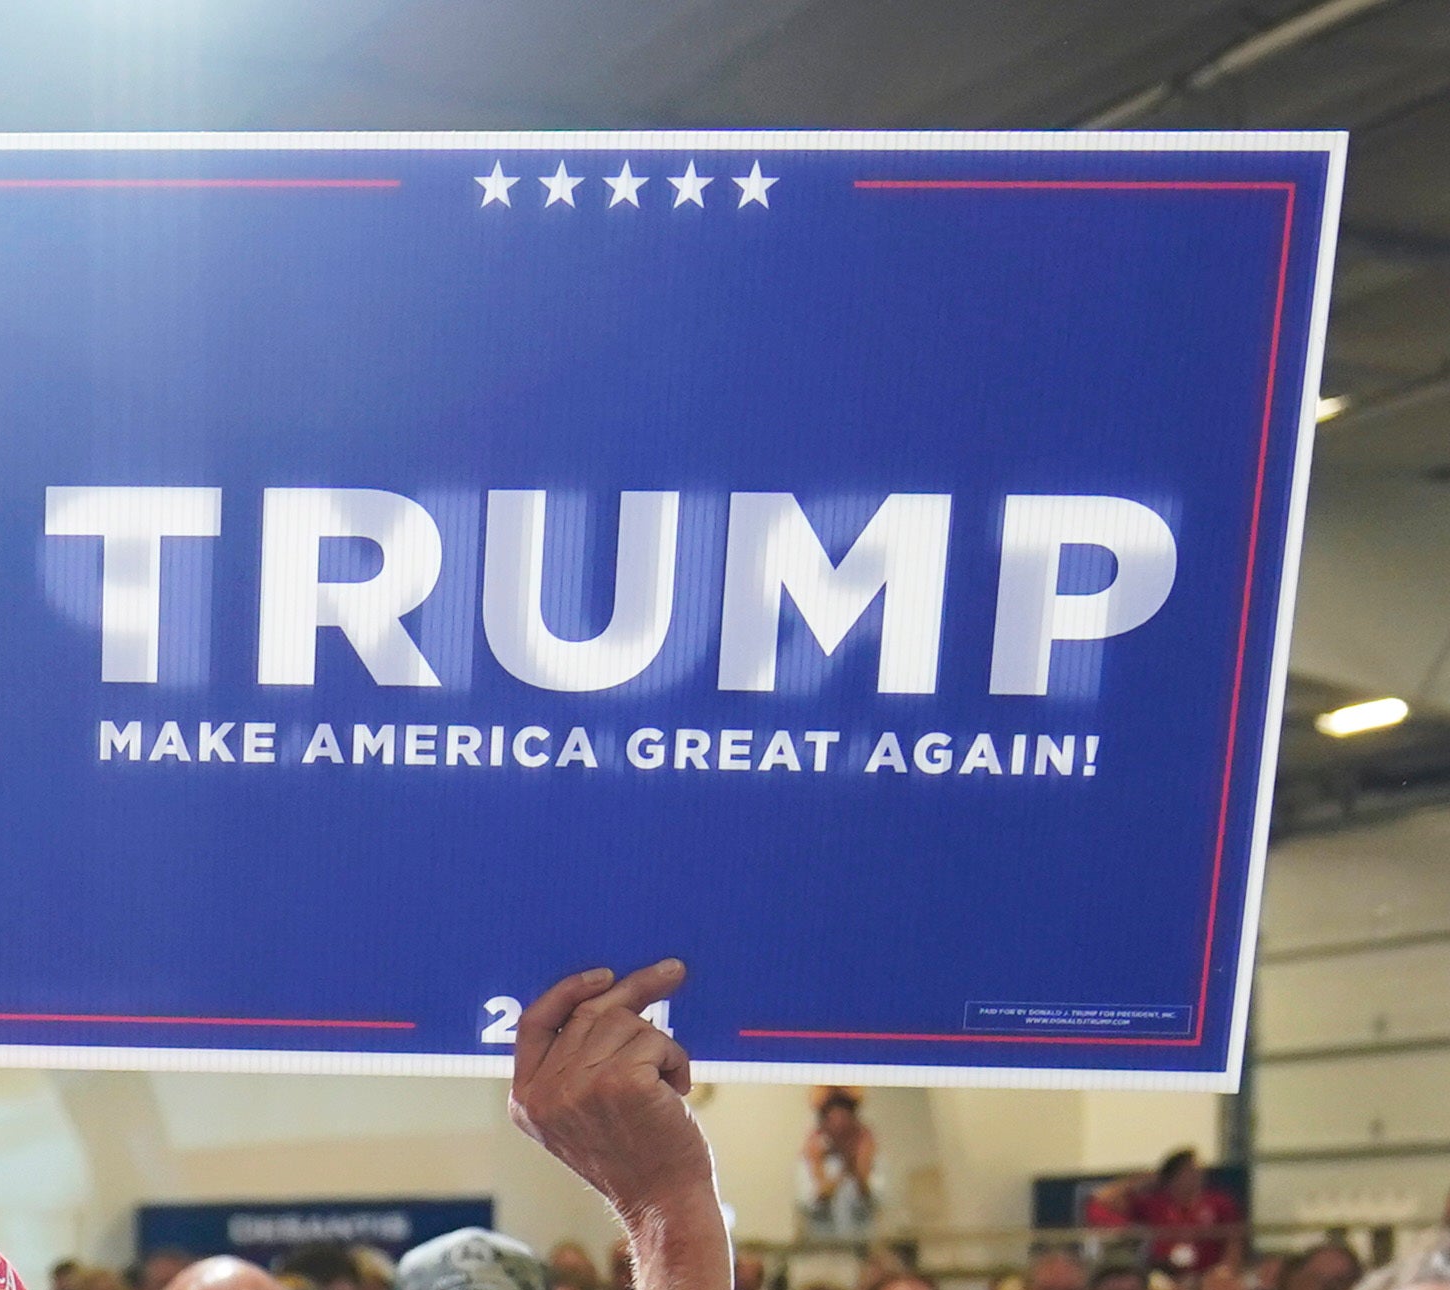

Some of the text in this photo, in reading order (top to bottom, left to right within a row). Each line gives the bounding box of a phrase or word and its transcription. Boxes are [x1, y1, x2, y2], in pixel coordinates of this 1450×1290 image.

[44, 485, 1179, 696] TRUMP
[99, 719, 1101, 778] MAKE AMERICA GREAT AGAIN!
[1029, 1008, 1062, 1016] DONALD
